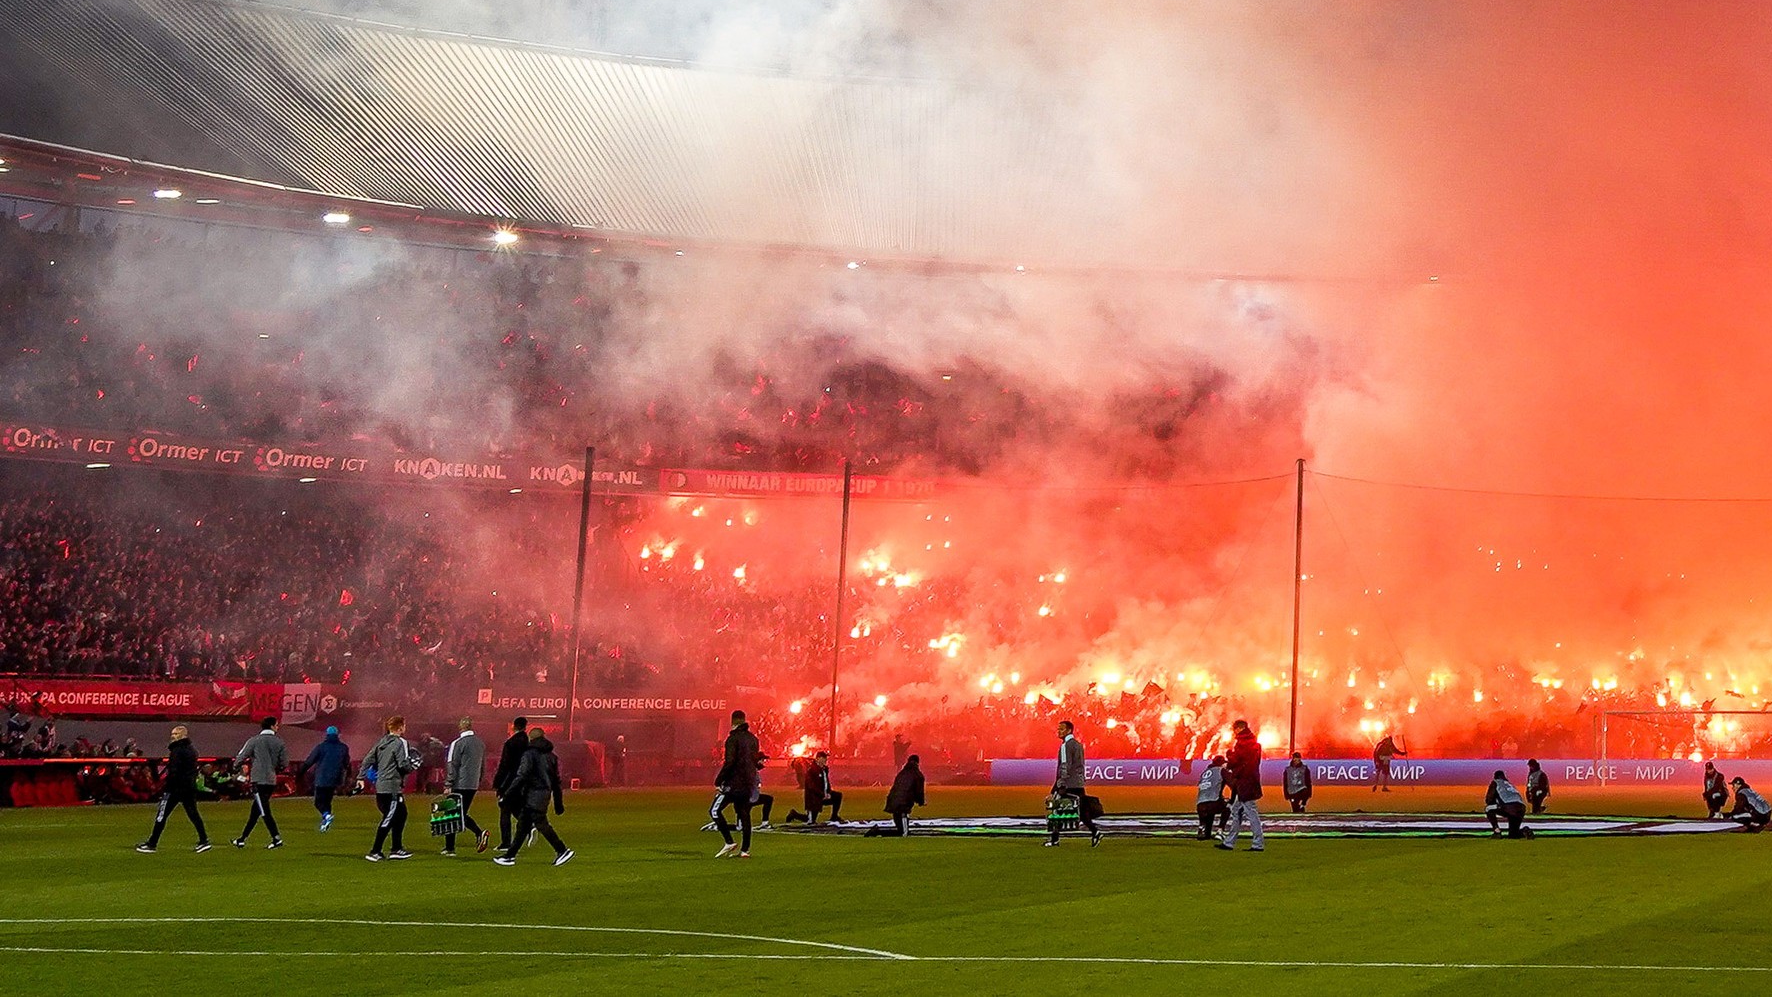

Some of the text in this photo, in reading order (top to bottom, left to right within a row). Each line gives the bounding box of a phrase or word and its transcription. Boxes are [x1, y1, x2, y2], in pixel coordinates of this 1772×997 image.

[88, 438, 115, 453] ICT
[139, 438, 245, 464] Ormer ICT
[266, 448, 368, 472] Ormer ICT
[394, 457, 507, 481] KNAKEN.NL
[706, 473, 780, 492] WINNAAR
[58, 691, 139, 706] CONFERENCE
[143, 693, 190, 707] LEAGUE
[530, 697, 580, 710] EUROA
[583, 697, 672, 711] CONFERENCE
[676, 698, 727, 711] LEAGUE
[1084, 765, 1124, 780] EACE
[1316, 765, 1369, 780] PEACE
[1564, 765, 1617, 781] PEACE
